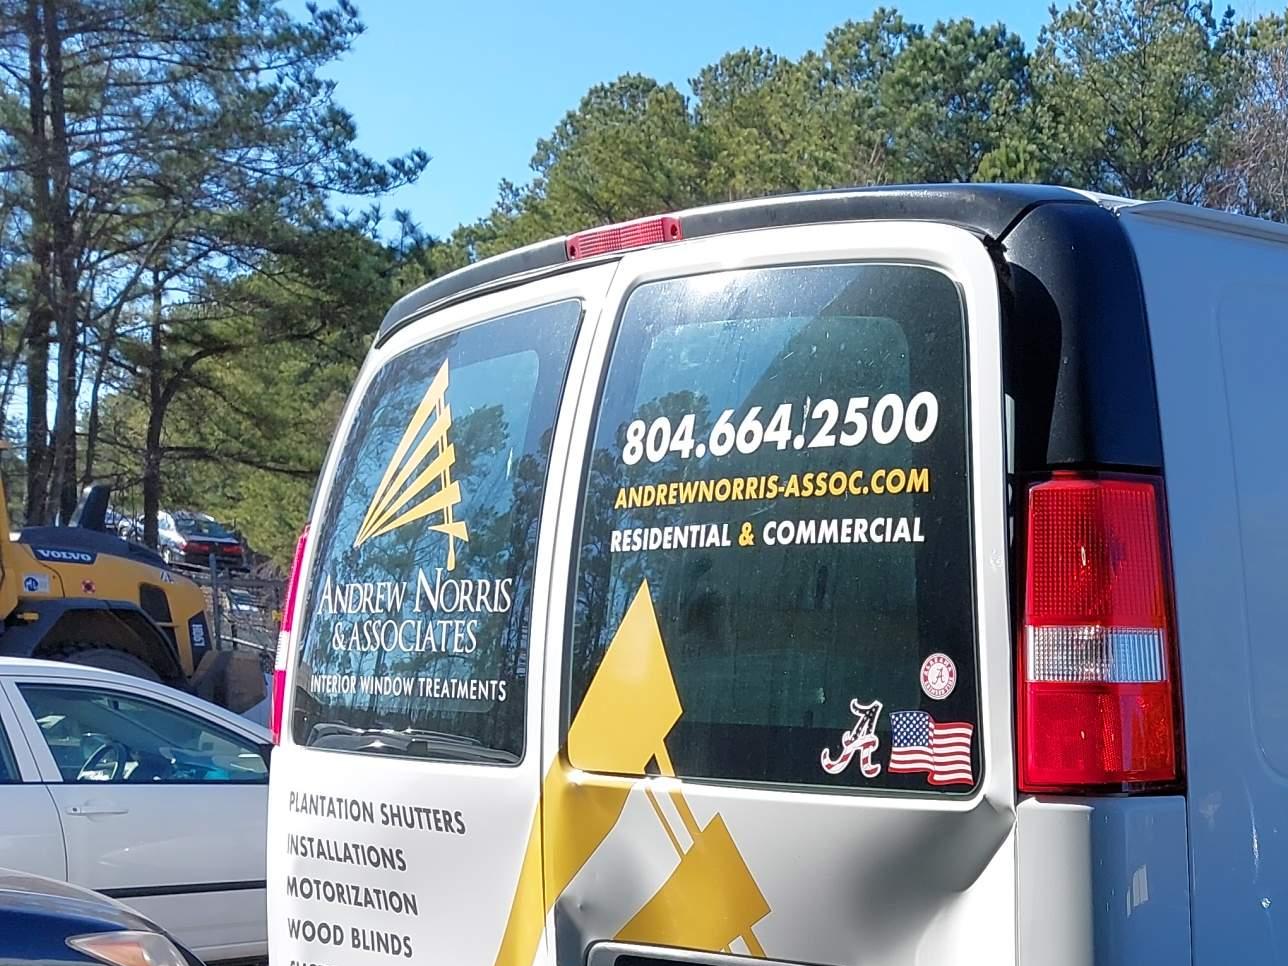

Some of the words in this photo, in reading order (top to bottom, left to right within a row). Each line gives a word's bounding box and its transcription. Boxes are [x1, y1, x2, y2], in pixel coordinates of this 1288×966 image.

[622, 391, 938, 466] 804.664.2500
[614, 468, 929, 509] ANDREWNORRIS-ASSOC.COM
[37, 549, 92, 561] VOLVO
[610, 523, 731, 553] RESIDENTIAL
[738, 522, 755, 547] &
[763, 517, 925, 546] COMMERCIAL
[318, 579, 407, 614] ANDREW
[413, 567, 513, 613] NORRIS
[310, 674, 357, 695] INTERIOR
[360, 677, 412, 698] WINDOW
[418, 677, 507, 702] TREATMENTS
[289, 791, 374, 824] PLANTATION
[381, 803, 466, 835] SHUTTERS
[287, 833, 407, 872] INSTALLATIONS
[286, 875, 418, 916] MOTORIZATION
[288, 917, 344, 946] WOOD
[351, 928, 413, 958] BLINDS
